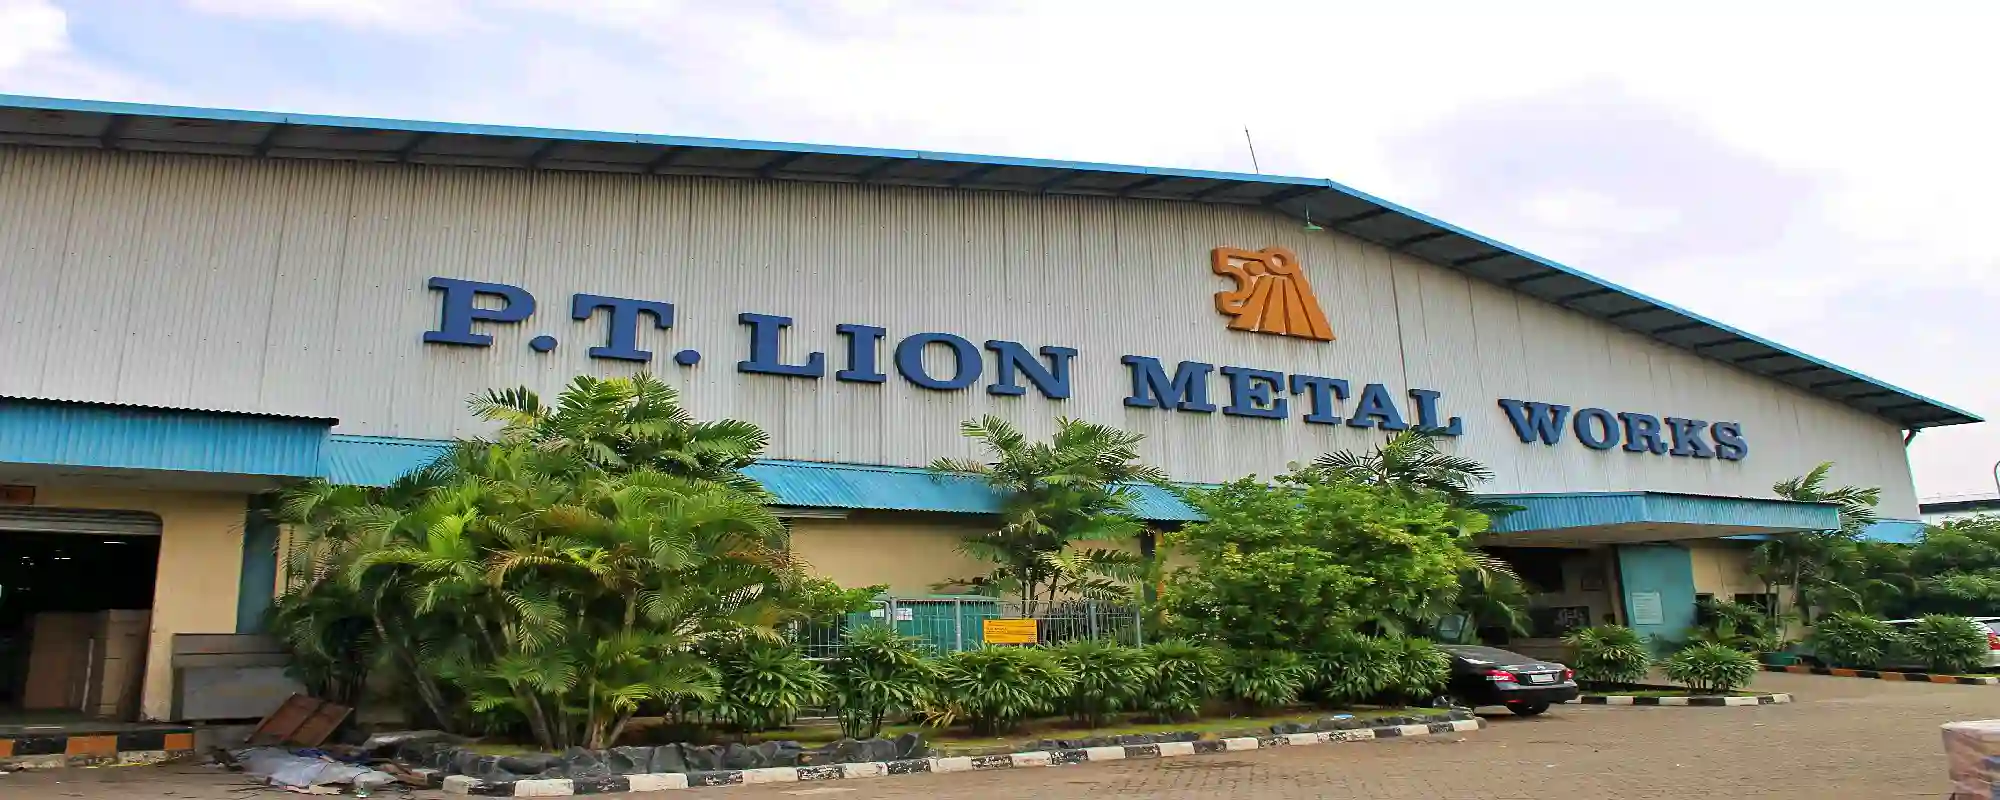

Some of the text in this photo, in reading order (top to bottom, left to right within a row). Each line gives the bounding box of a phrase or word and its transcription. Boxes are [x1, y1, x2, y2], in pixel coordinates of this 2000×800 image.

[423, 276, 1748, 461] P.T. LION METAL WORKS
